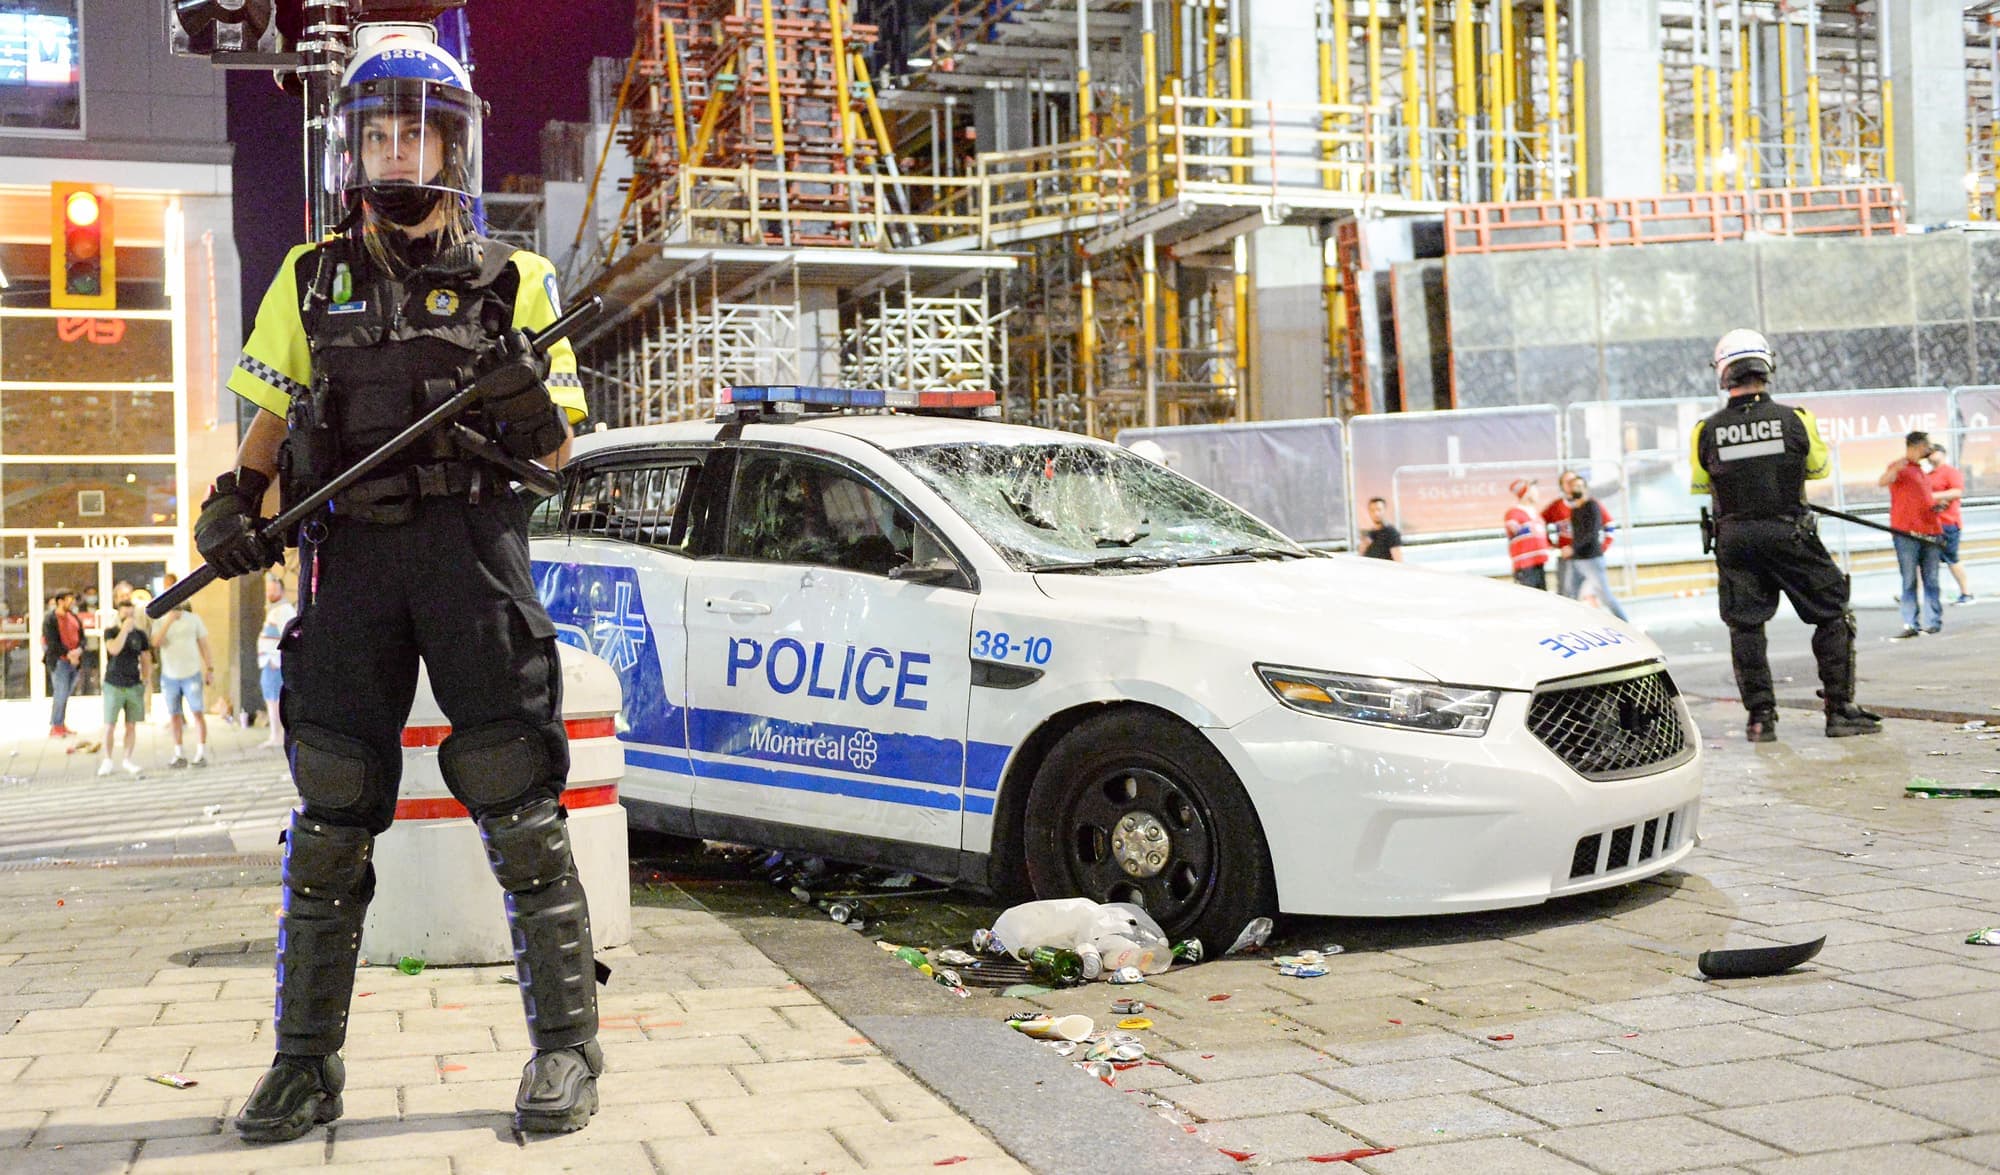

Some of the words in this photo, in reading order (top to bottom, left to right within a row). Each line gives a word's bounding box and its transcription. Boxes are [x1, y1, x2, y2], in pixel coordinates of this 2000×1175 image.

[1715, 420, 1783, 446] POLICE
[1861, 415, 1892, 438] LA
[1896, 413, 1937, 434] VIE
[81, 533, 130, 549] 1016
[973, 630, 1053, 665] 38-10
[727, 636, 931, 711] POLICE
[750, 727, 845, 761] Montréal
